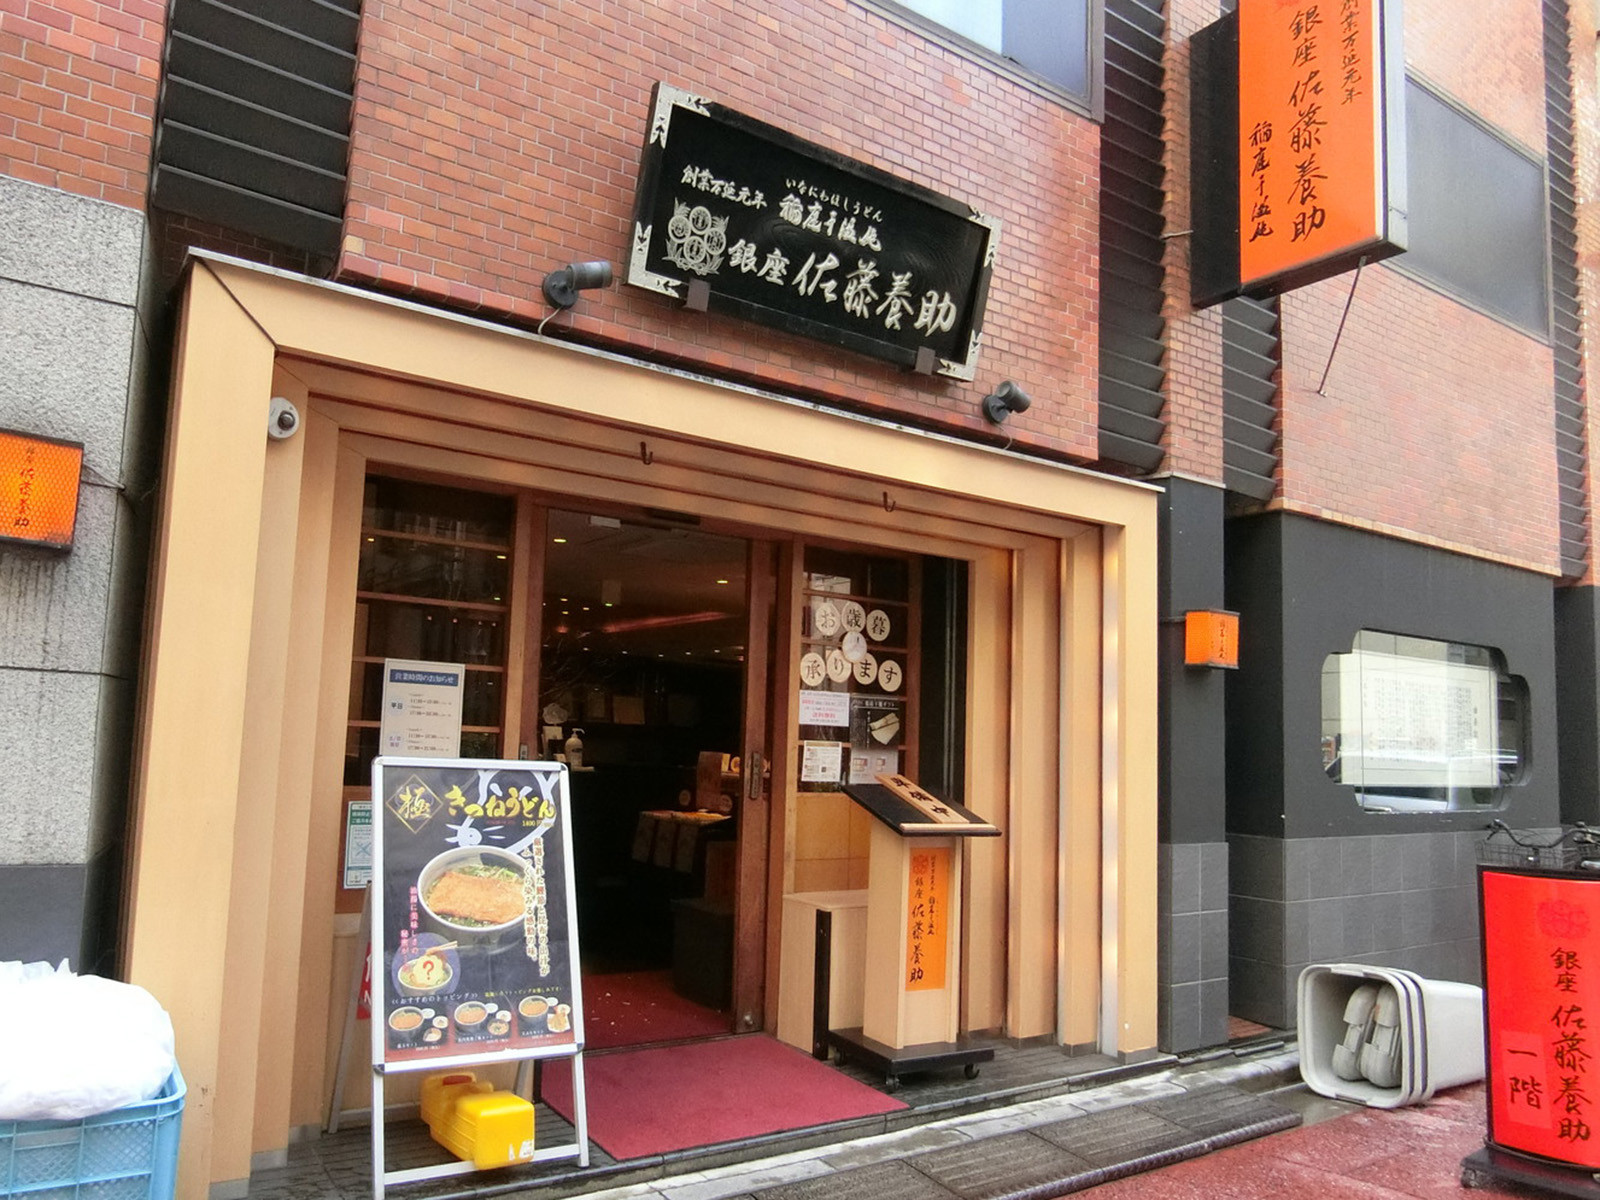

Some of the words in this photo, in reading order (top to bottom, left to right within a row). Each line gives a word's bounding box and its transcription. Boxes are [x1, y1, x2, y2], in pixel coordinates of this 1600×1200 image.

[1288, 5, 1328, 242] 銀座佐藤養助
[680, 163, 768, 210] 創業万延元年
[785, 178, 884, 224] いなにわほしうどん
[820, 608, 886, 636] お歳暮
[397, 785, 433, 820] 極
[444, 784, 557, 819] きつねうどん
[1550, 947, 1592, 1142] 銀座佐藤養助
[1506, 1047, 1544, 1110] 一階
